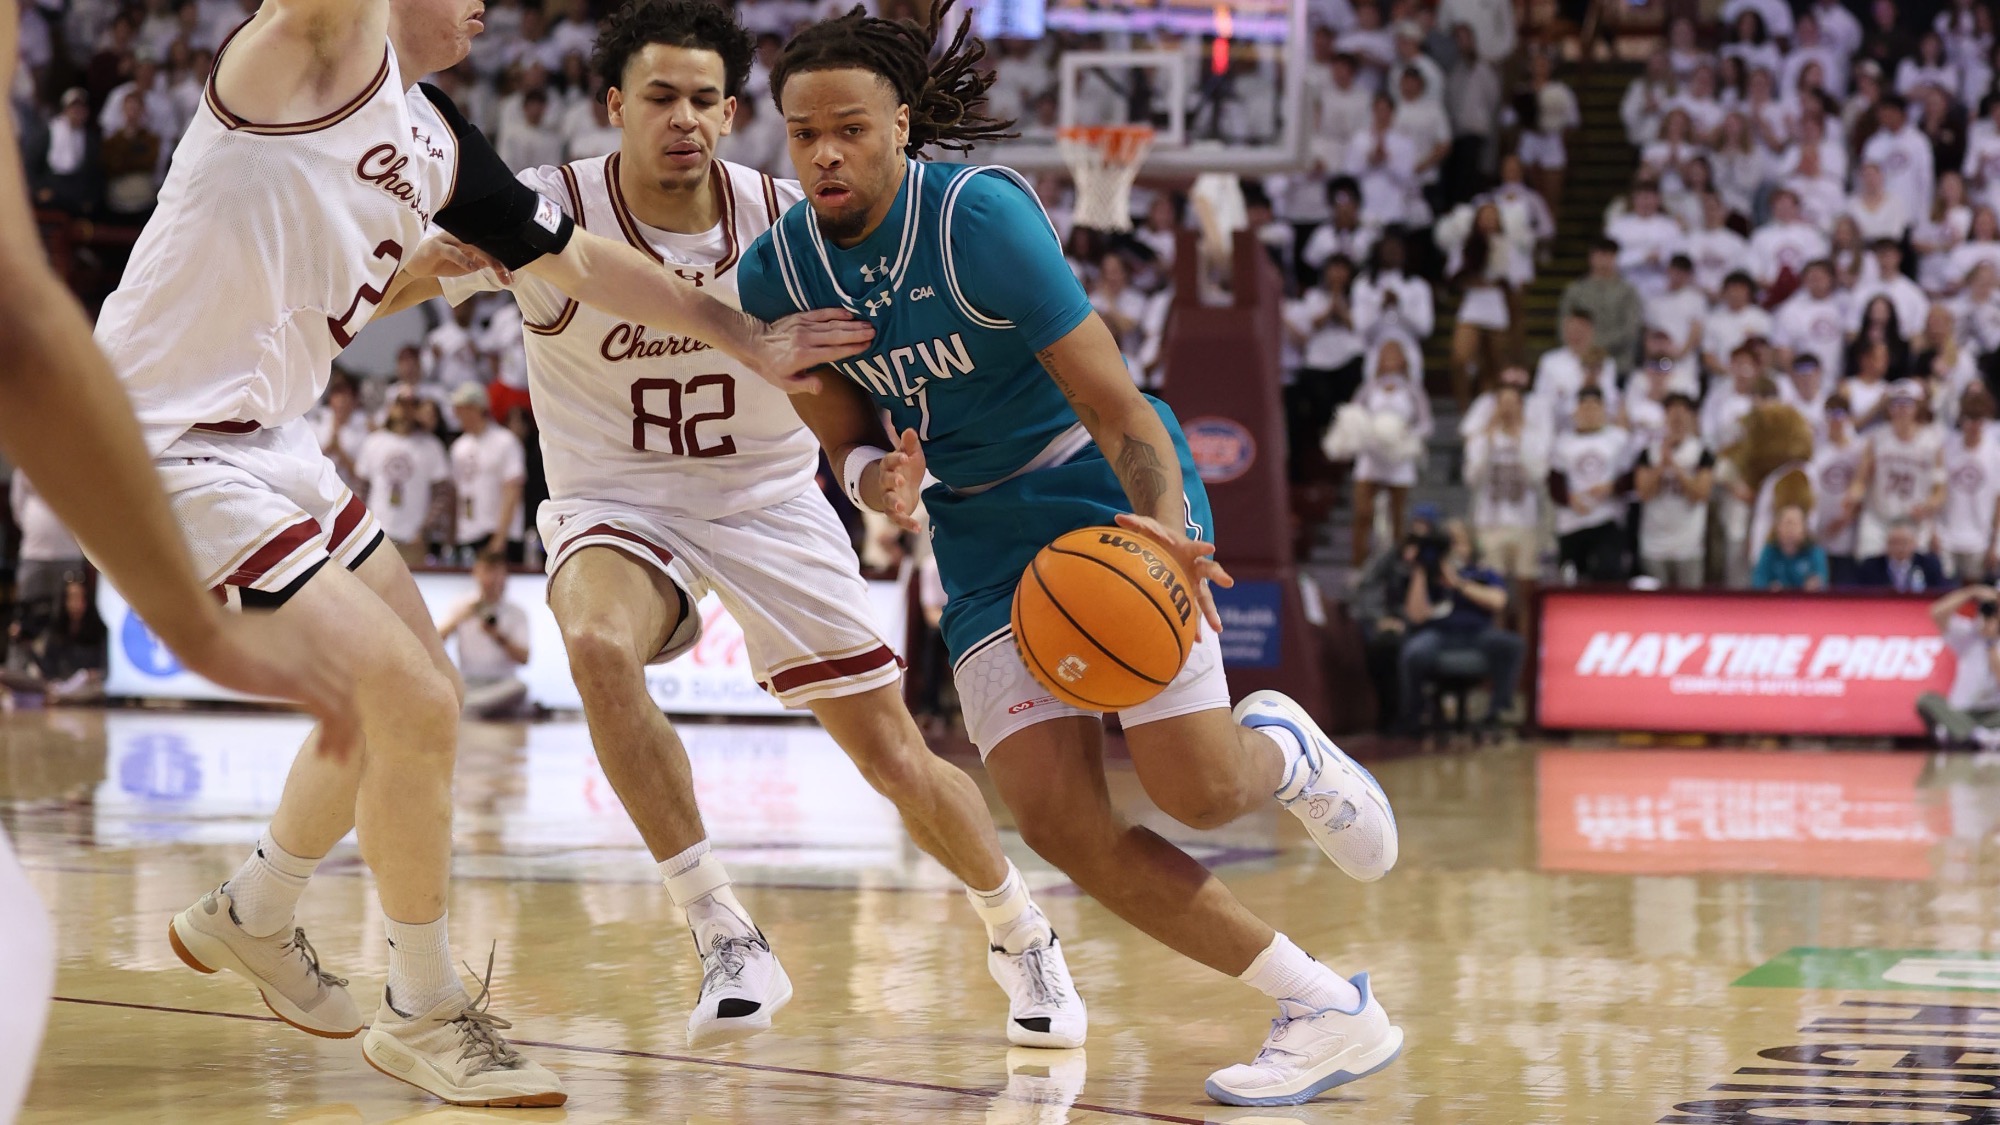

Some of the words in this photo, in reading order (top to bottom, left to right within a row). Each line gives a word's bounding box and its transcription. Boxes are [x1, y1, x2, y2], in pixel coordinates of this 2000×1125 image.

[909, 285, 936, 301] CAA
[1098, 532, 1192, 628] Wilson
[1576, 632, 1702, 676] HAY
[1703, 633, 1811, 678] TIRE
[1809, 634, 1944, 681] PROS
